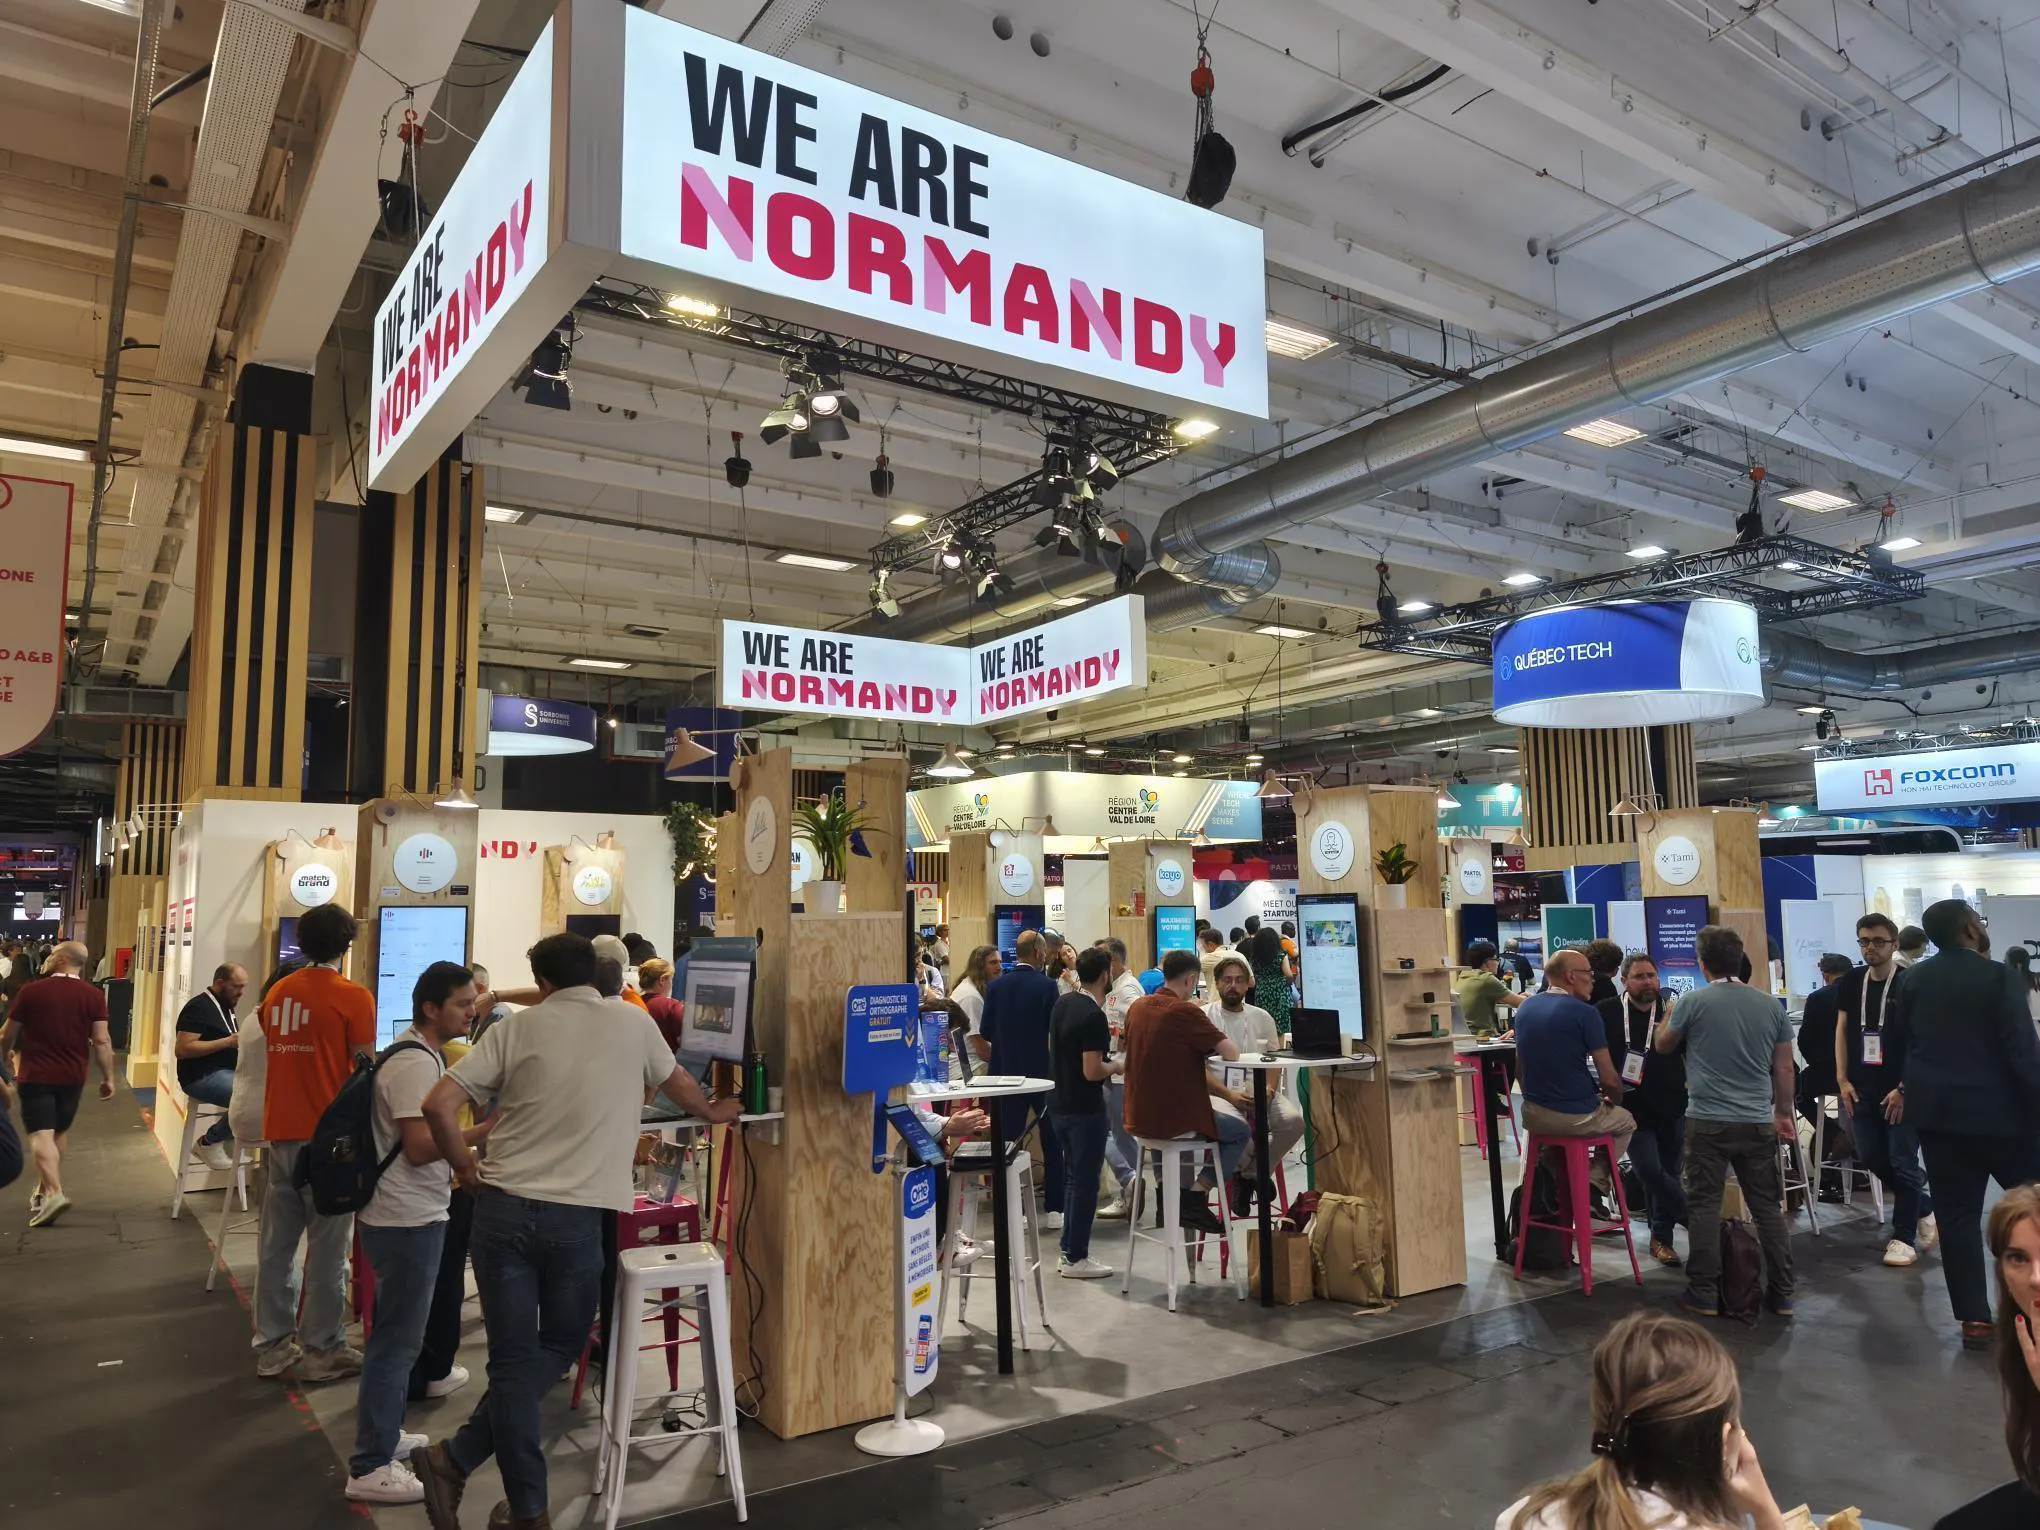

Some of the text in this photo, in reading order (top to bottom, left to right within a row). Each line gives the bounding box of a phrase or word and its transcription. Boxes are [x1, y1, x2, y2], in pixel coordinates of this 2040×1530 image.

[683, 52, 990, 239] WE ARE
[680, 161, 1236, 389] NORMANDY
[382, 220, 446, 385] WE ARE
[377, 178, 533, 457] NORMANDY
[14, 651, 54, 664] A&B
[742, 630, 854, 676] WE ARE
[1514, 641, 1613, 671] QUÉBEC TECH
[979, 634, 1045, 684] WE ARE
[980, 648, 1121, 715] NORMANDY
[741, 668, 957, 716] NORMANDY
[1933, 781, 1986, 792] TECHNOLOGY
[1988, 778, 2017, 787] GROUP
[1227, 791, 1250, 799] WHERE
[1108, 796, 1137, 806] RÉGION
[1223, 799, 1240, 807] TECH
[953, 803, 974, 814] RÉGION
[1108, 806, 1138, 815] CENTRE
[1217, 808, 1240, 817] MAKES
[953, 813, 974, 823] CENTRE
[1108, 815, 1123, 824] VAL
[1134, 816, 1156, 824] LOIRE
[1211, 817, 1234, 825] SENSE
[953, 823, 963, 831] VAL
[1670, 853, 1694, 863] Tami
[1159, 868, 1182, 882] kayo
[1263, 900, 1283, 908] MEET
[1263, 910, 1298, 918] STARTUPS
[869, 994, 908, 1005] DIAGNOSTIC EN
[869, 1005, 908, 1015] ORTHOGRAPHE
[869, 1016, 892, 1026] GRATUIT
